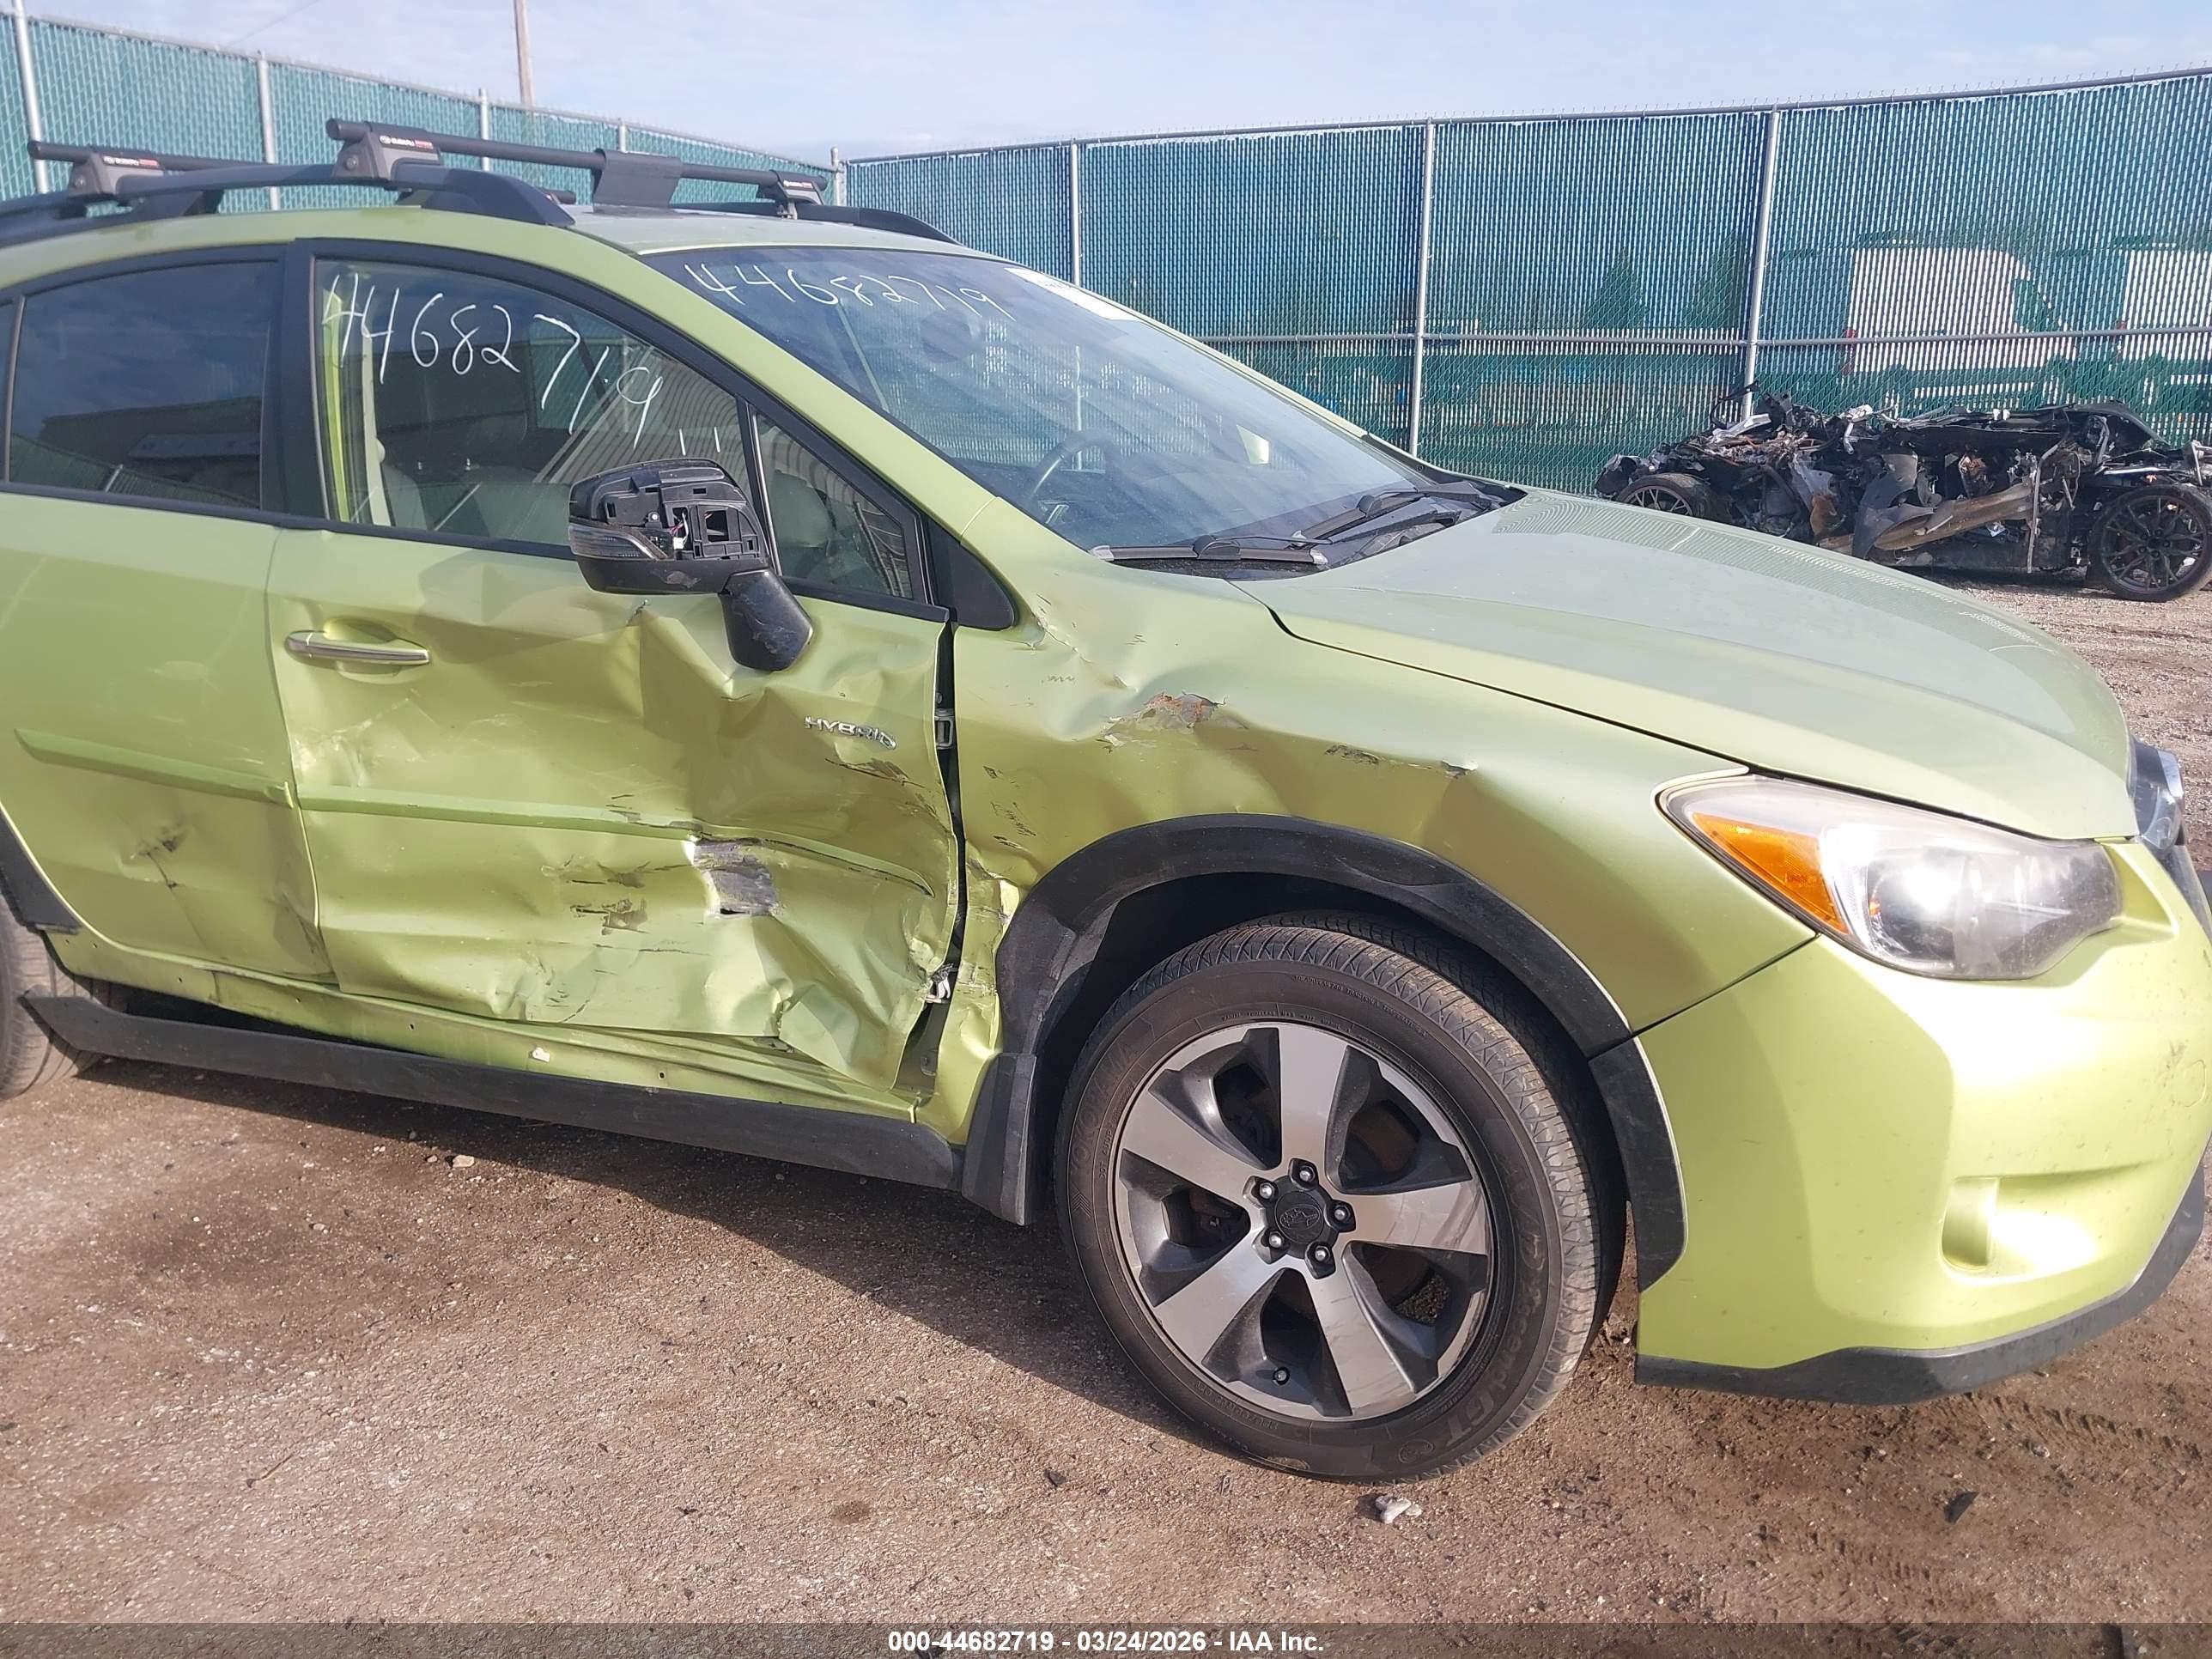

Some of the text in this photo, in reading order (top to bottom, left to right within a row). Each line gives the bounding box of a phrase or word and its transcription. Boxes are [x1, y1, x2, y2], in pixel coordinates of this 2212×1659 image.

[684, 262, 1016, 321] 44682719
[322, 272, 663, 450] 44682719
[805, 715, 896, 750] HYBRID
